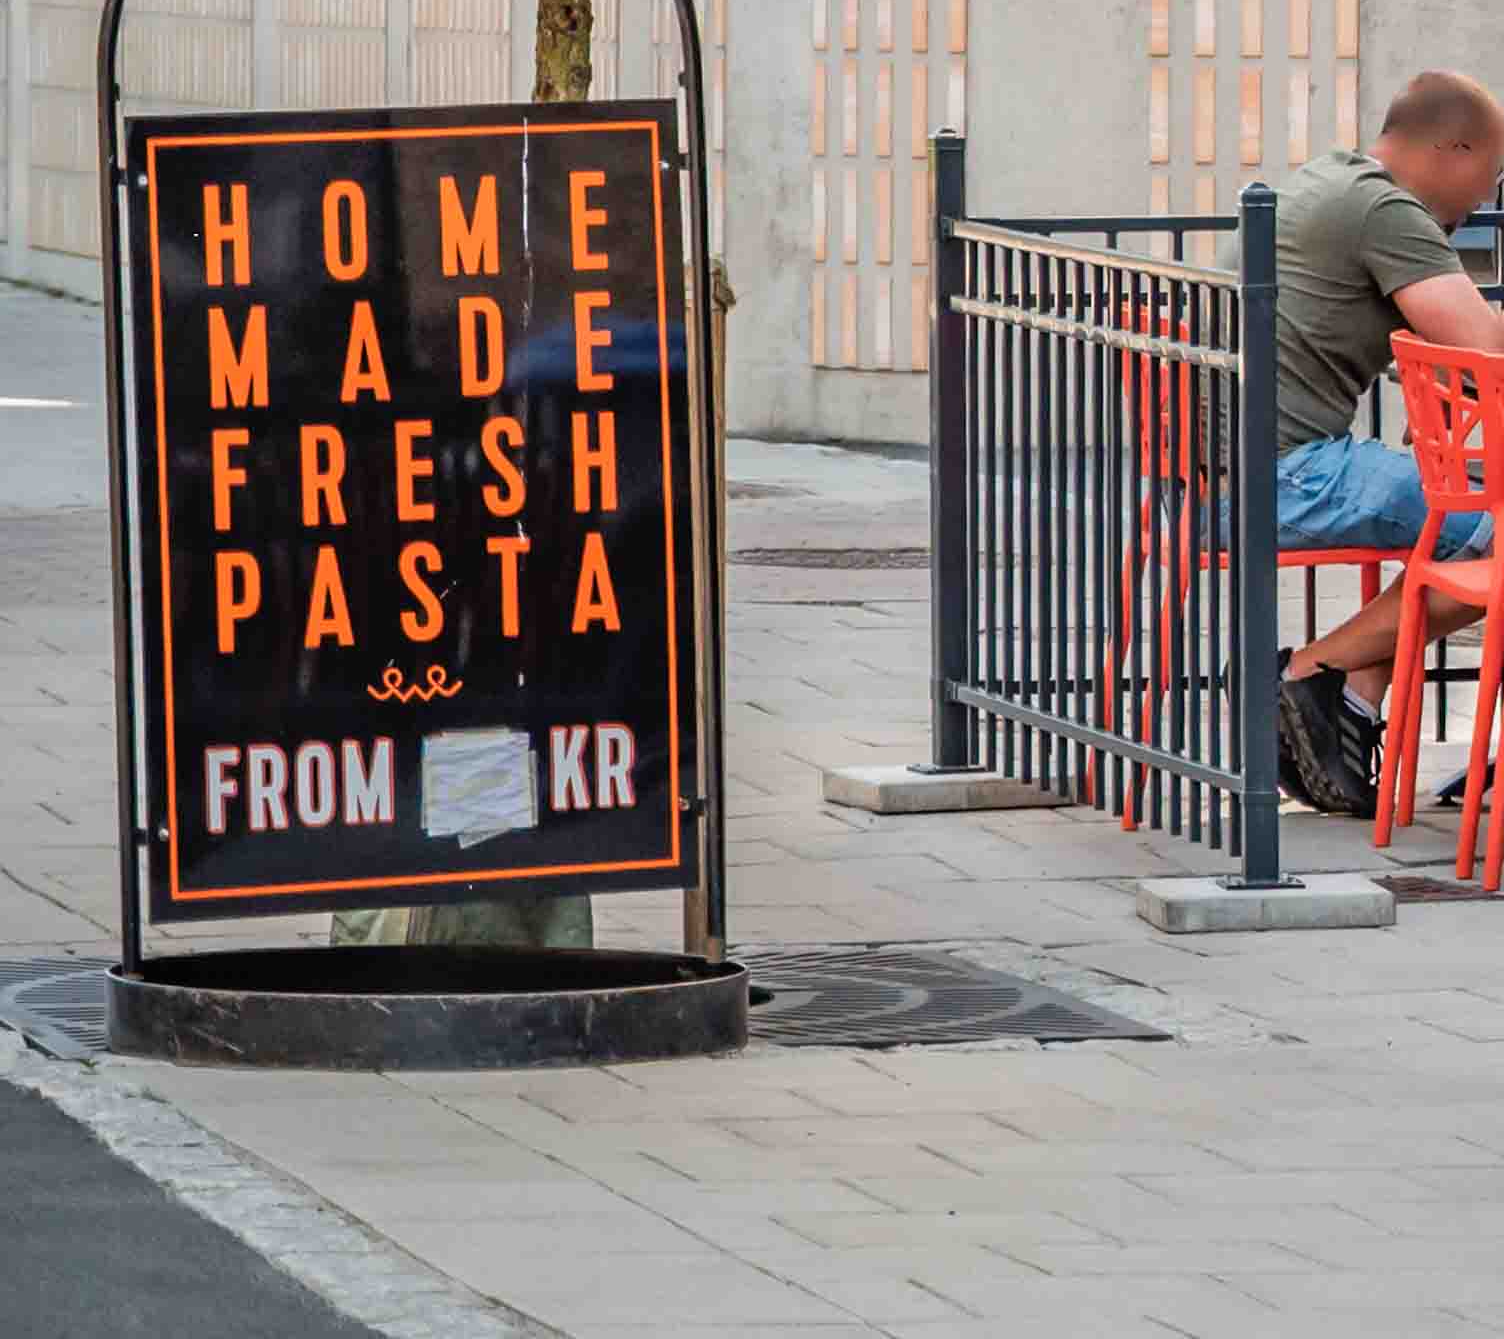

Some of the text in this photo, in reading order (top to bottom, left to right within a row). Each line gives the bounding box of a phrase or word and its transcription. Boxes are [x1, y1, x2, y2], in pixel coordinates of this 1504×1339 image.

[203, 170, 609, 287] HOME
[207, 290, 614, 409] MADE
[212, 410, 618, 531] FRESH
[215, 532, 621, 654] PASTA
[204, 721, 636, 835] FROM KR
